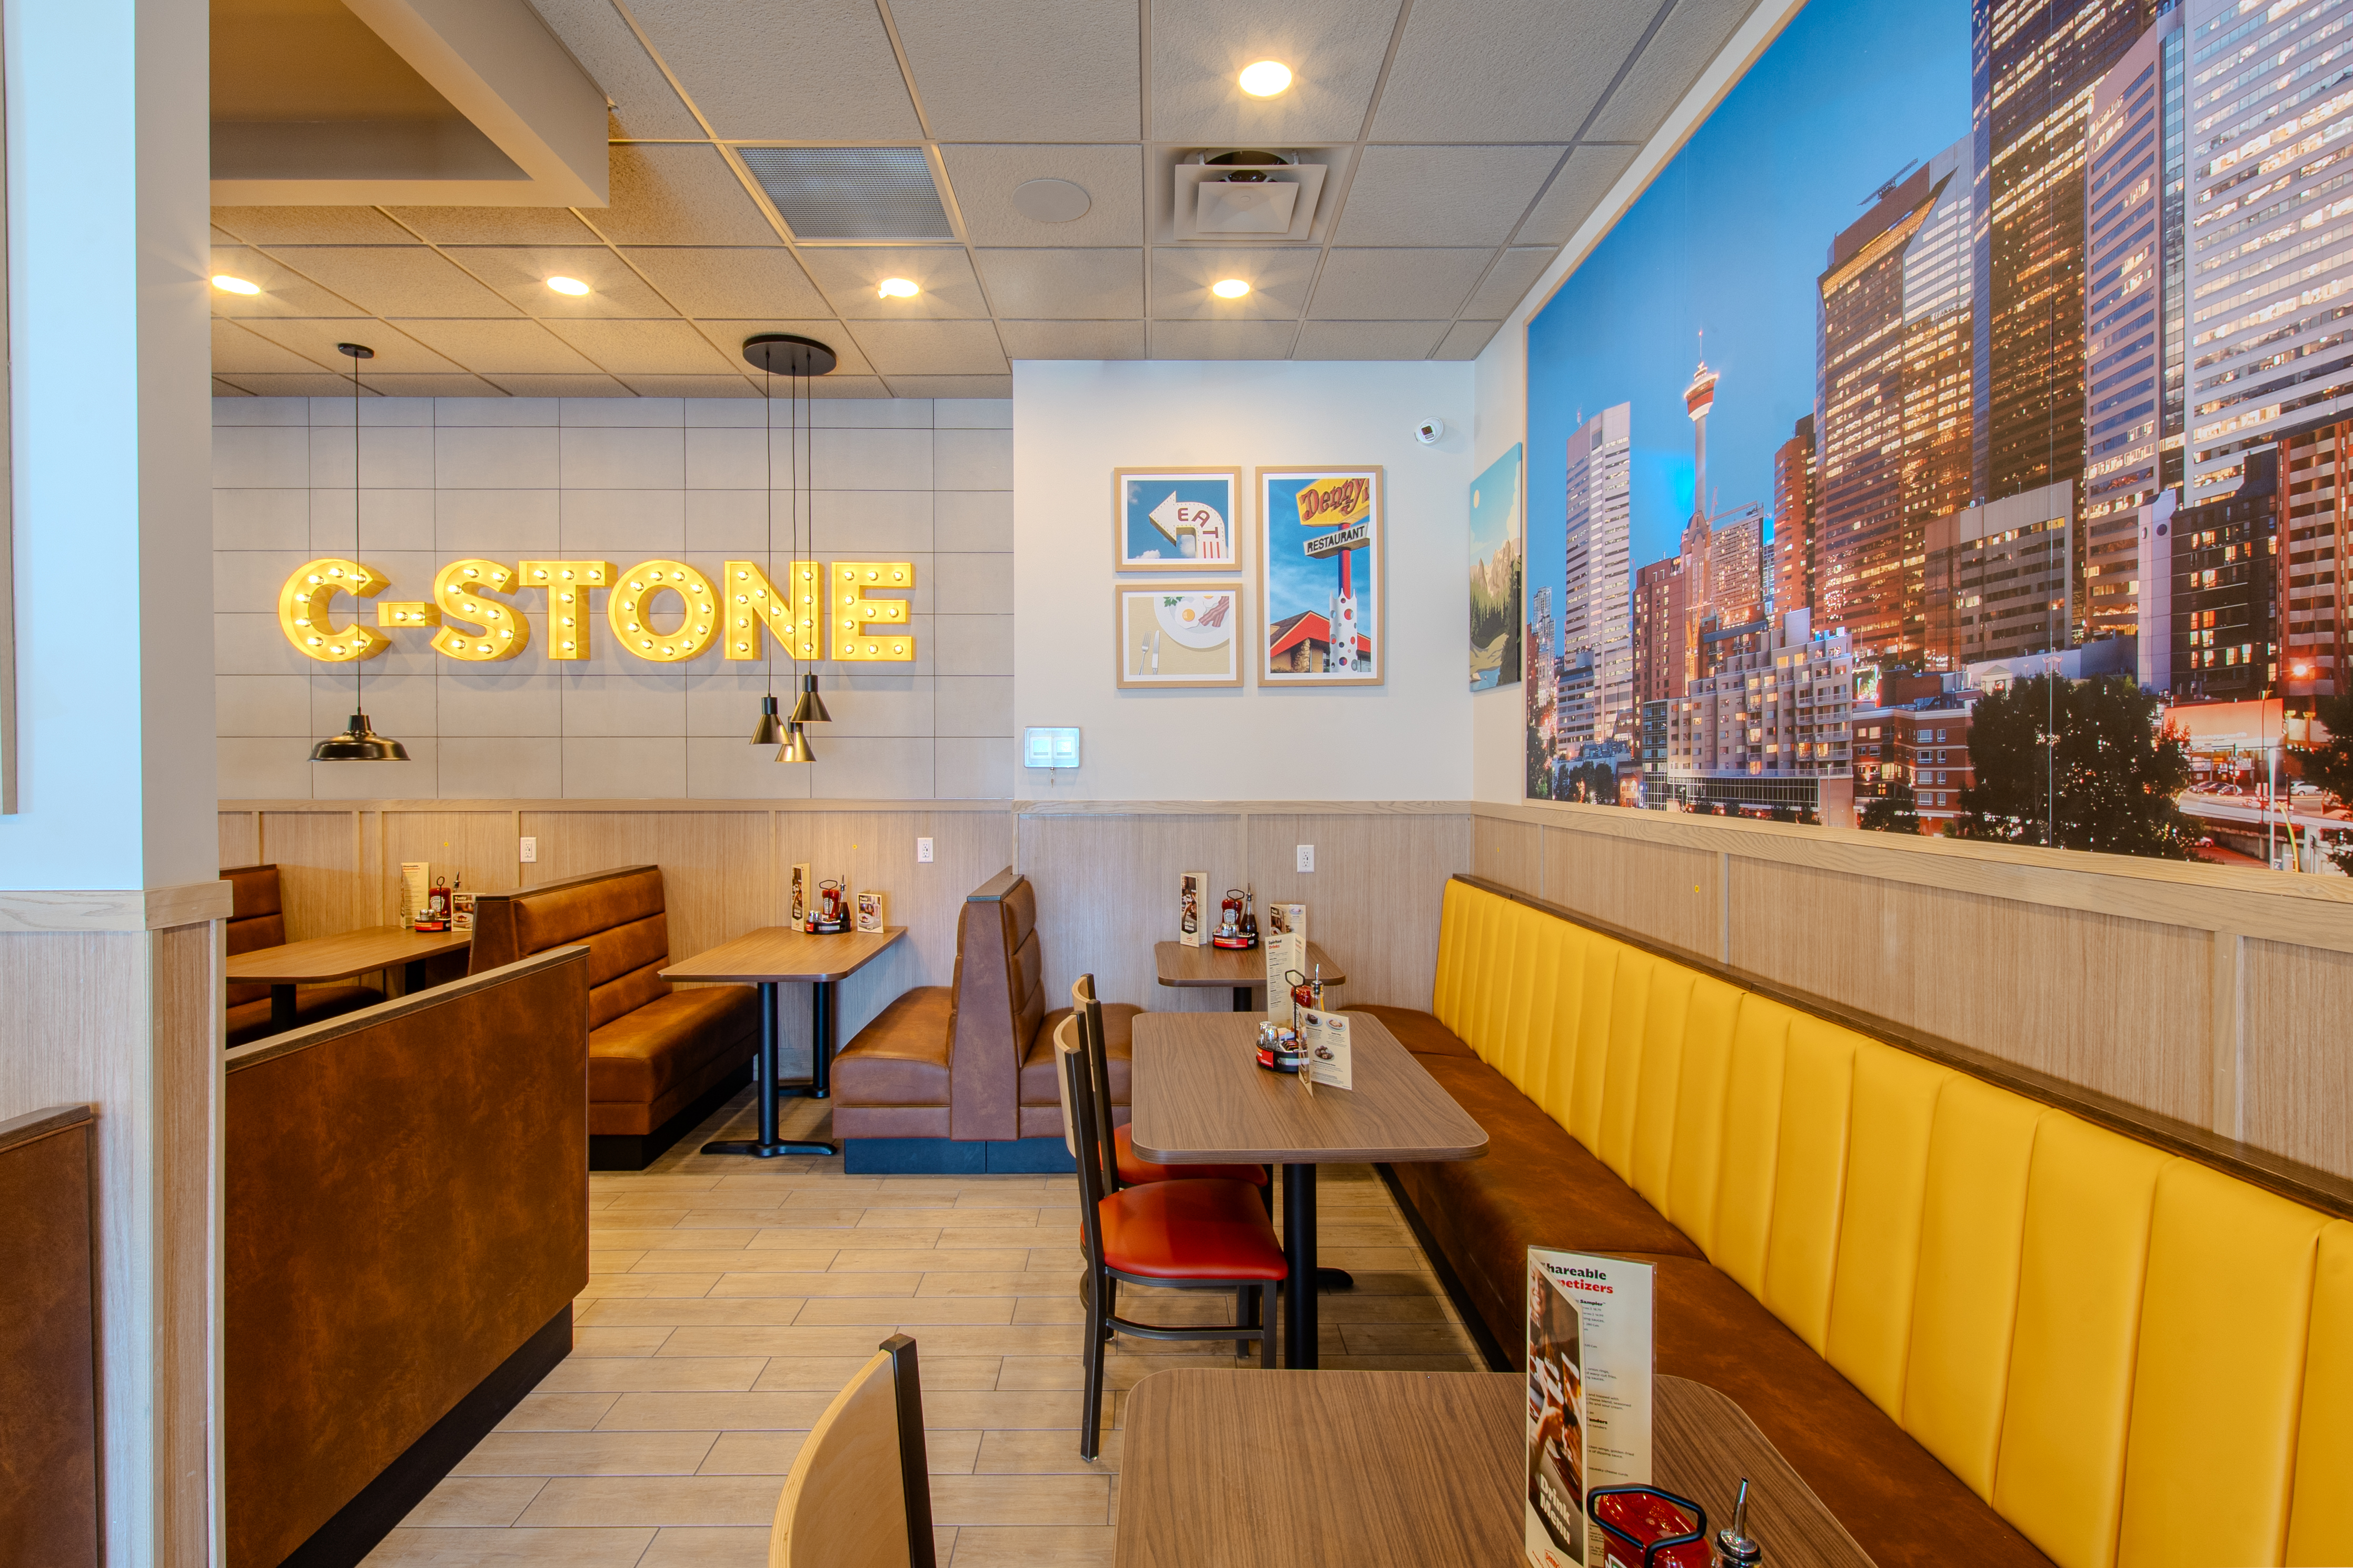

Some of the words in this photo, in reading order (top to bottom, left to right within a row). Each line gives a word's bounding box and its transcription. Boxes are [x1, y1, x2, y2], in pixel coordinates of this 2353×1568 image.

[1178, 507, 1218, 538] EAT
[1307, 526, 1365, 554] RESTAURANT
[277, 558, 917, 662] C-STONE
[1557, 1279, 1613, 1294] petizers
[1540, 1473, 1570, 1526] Drink
[1540, 1492, 1571, 1545] Menu
